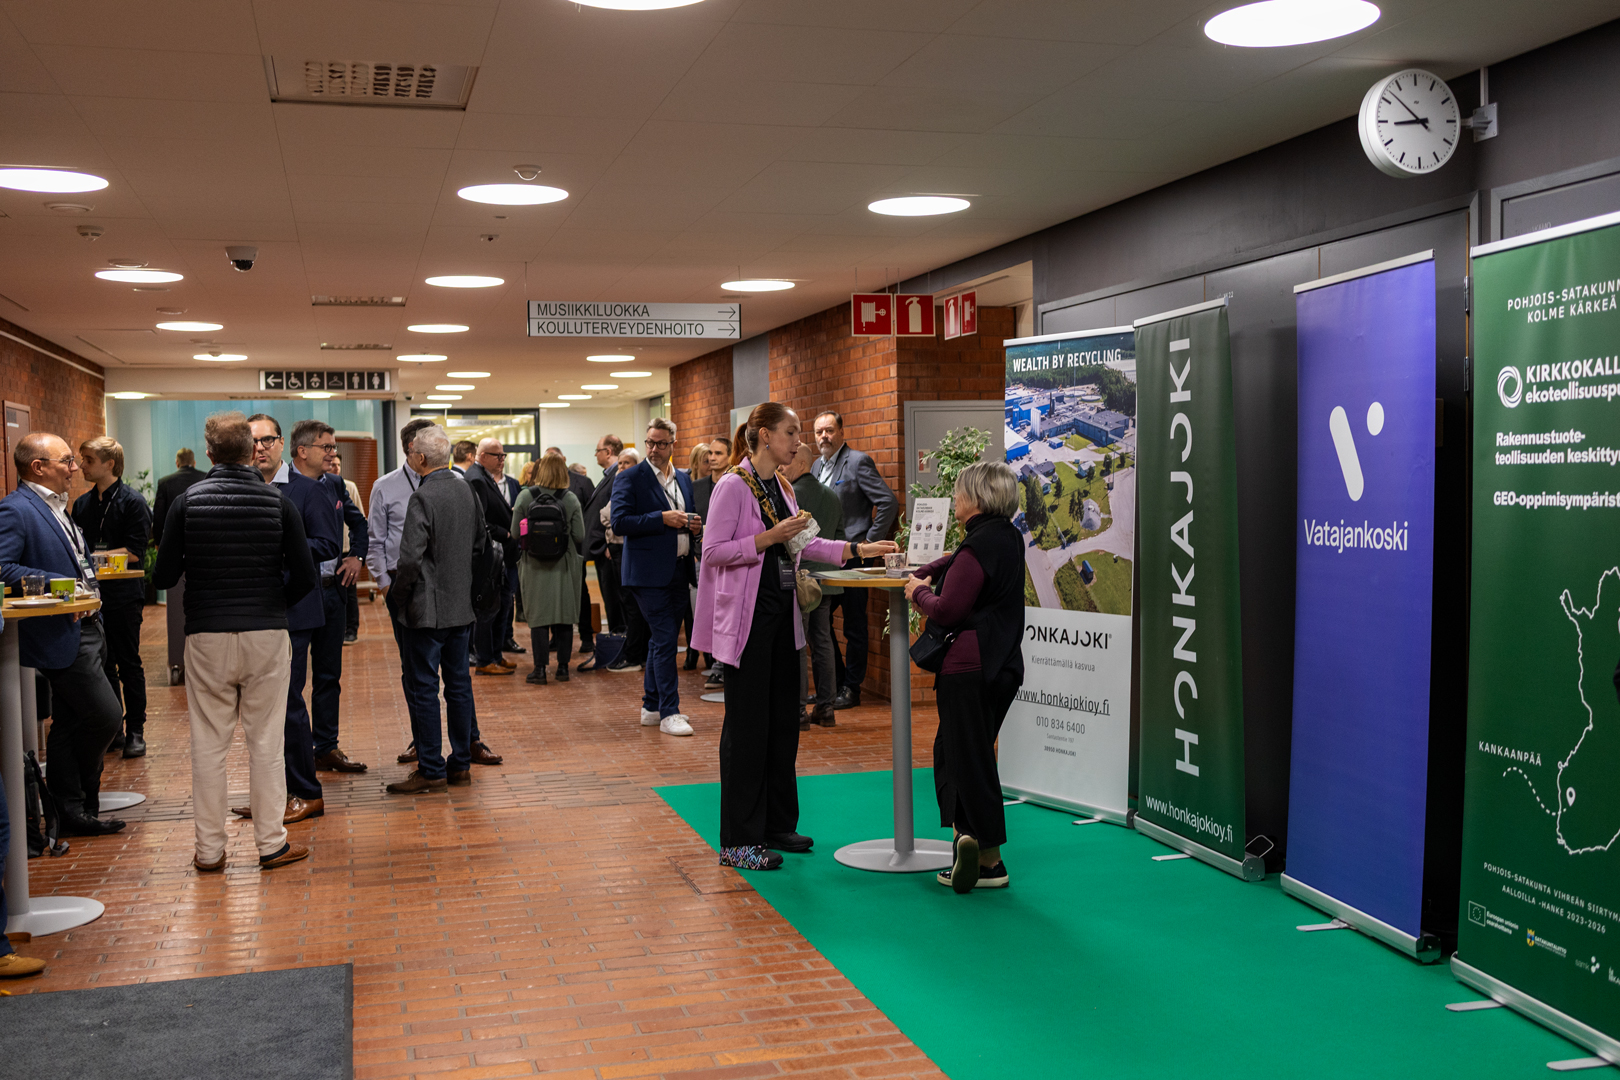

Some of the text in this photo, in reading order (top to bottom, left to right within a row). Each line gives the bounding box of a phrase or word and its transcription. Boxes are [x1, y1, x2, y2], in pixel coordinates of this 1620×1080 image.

[537, 303, 650, 317] MUSIIKKILUOKKA
[1527, 294, 1617, 323] KOLME KÄRKEÄ
[537, 321, 705, 336] KOULUTERVEYDENHOITO
[1013, 348, 1121, 373] WEALTH BY RECYCLING
[1495, 428, 1586, 447] Rakennustuote-
[1495, 446, 1620, 466] teollisuuden keskitty
[1304, 519, 1409, 554] Vatajankoski
[1169, 337, 1200, 777] HONKAJOKI
[1025, 624, 1108, 650] ONKAJOKI
[1031, 654, 1096, 672] Kierrättämällä kasvua
[1036, 715, 1086, 735] 010 834 6400
[1478, 740, 1542, 767] KANKAANPÄÄ
[1145, 794, 1233, 843] www.honkajokioy.fi
[1483, 861, 1551, 895] POHJOIS-SATAKUNTA
[1553, 888, 1585, 909] VIHREÄN
[1501, 884, 1607, 934] AALLOILLA -HANKE 2023-2026
